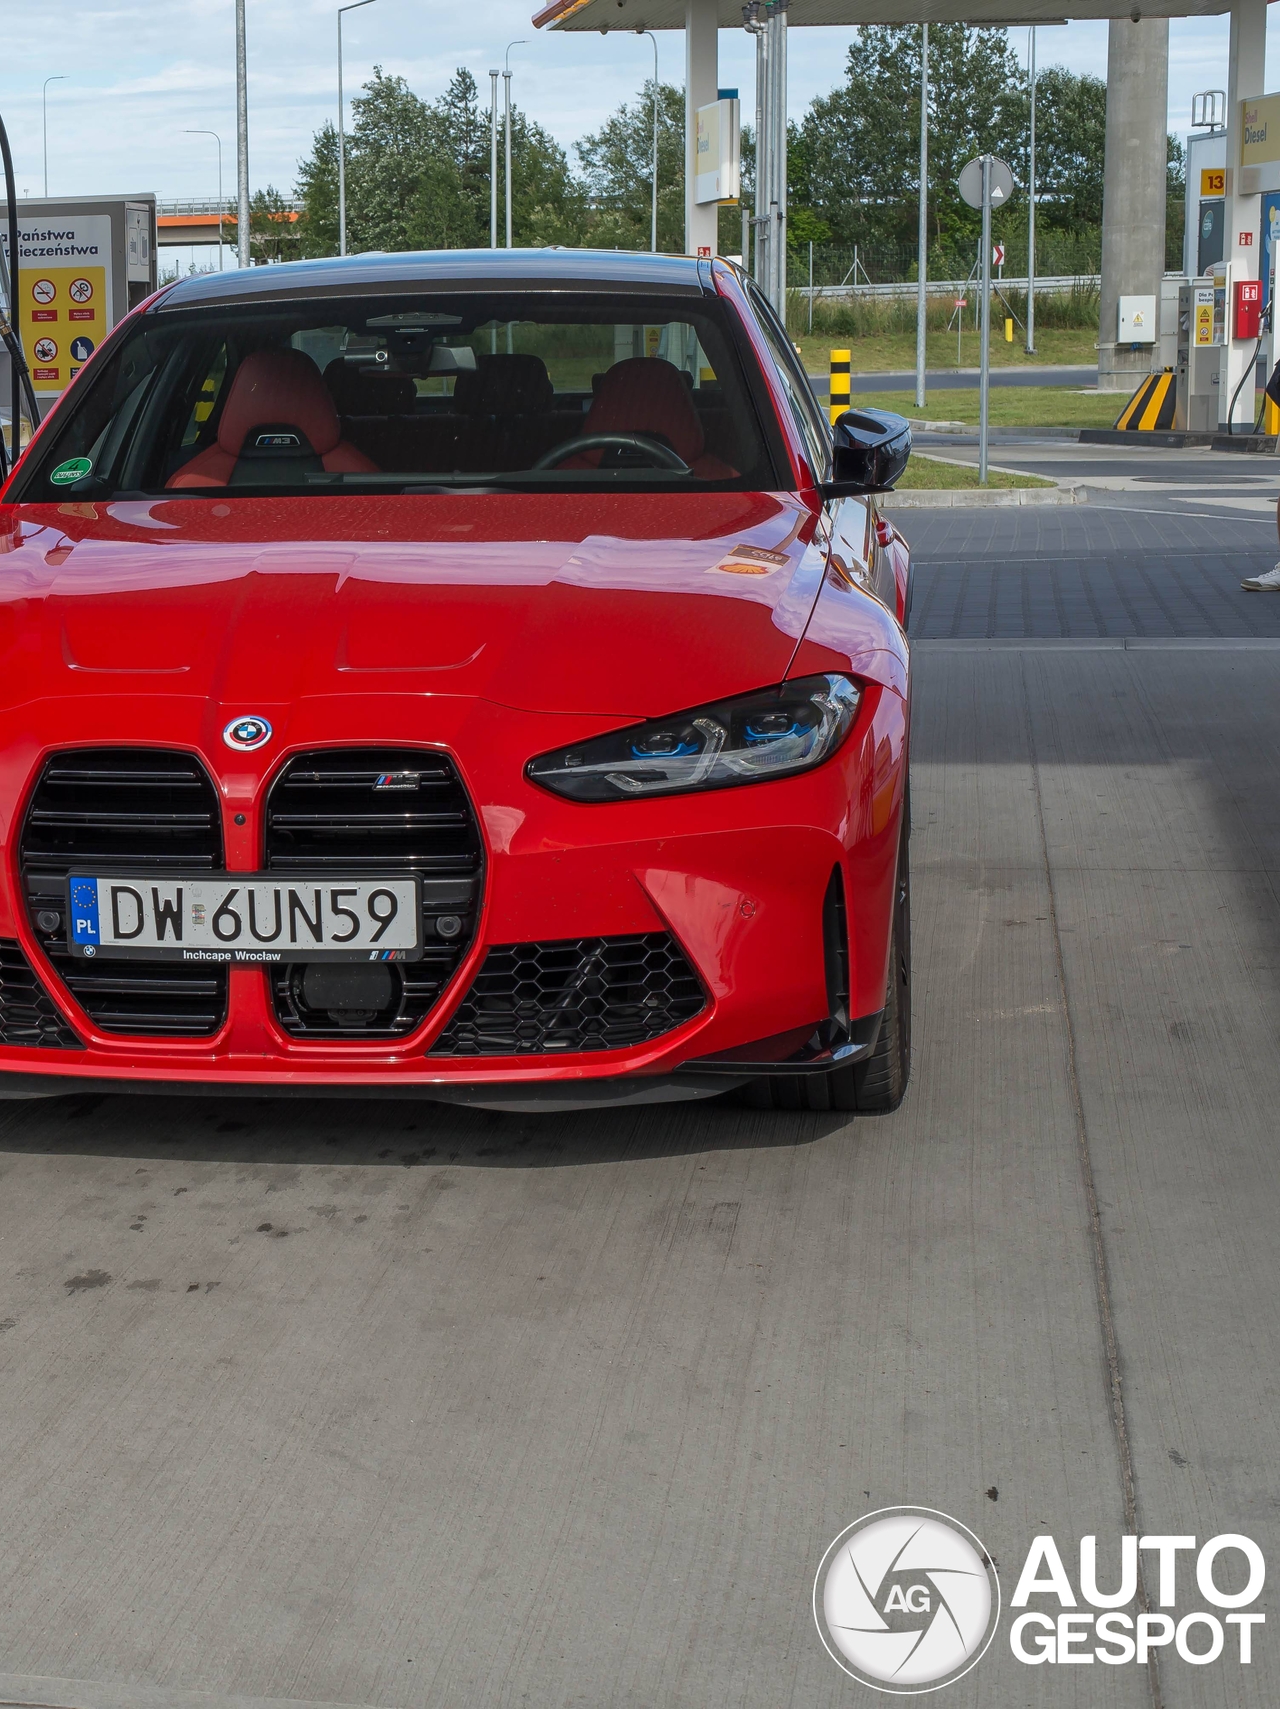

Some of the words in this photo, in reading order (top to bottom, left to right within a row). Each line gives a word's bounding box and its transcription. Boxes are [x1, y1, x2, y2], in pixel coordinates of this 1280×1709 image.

[1244, 121, 1267, 145] Diesel
[1208, 175, 1224, 190] 13
[5, 243, 98, 258] zieczeństwa
[68, 458, 82, 472] 4
[110, 884, 183, 942] DW
[212, 886, 398, 943] 6UN59
[76, 919, 96, 934] PL
[183, 950, 232, 962] Inchcape
[234, 951, 281, 961] Wrocław
